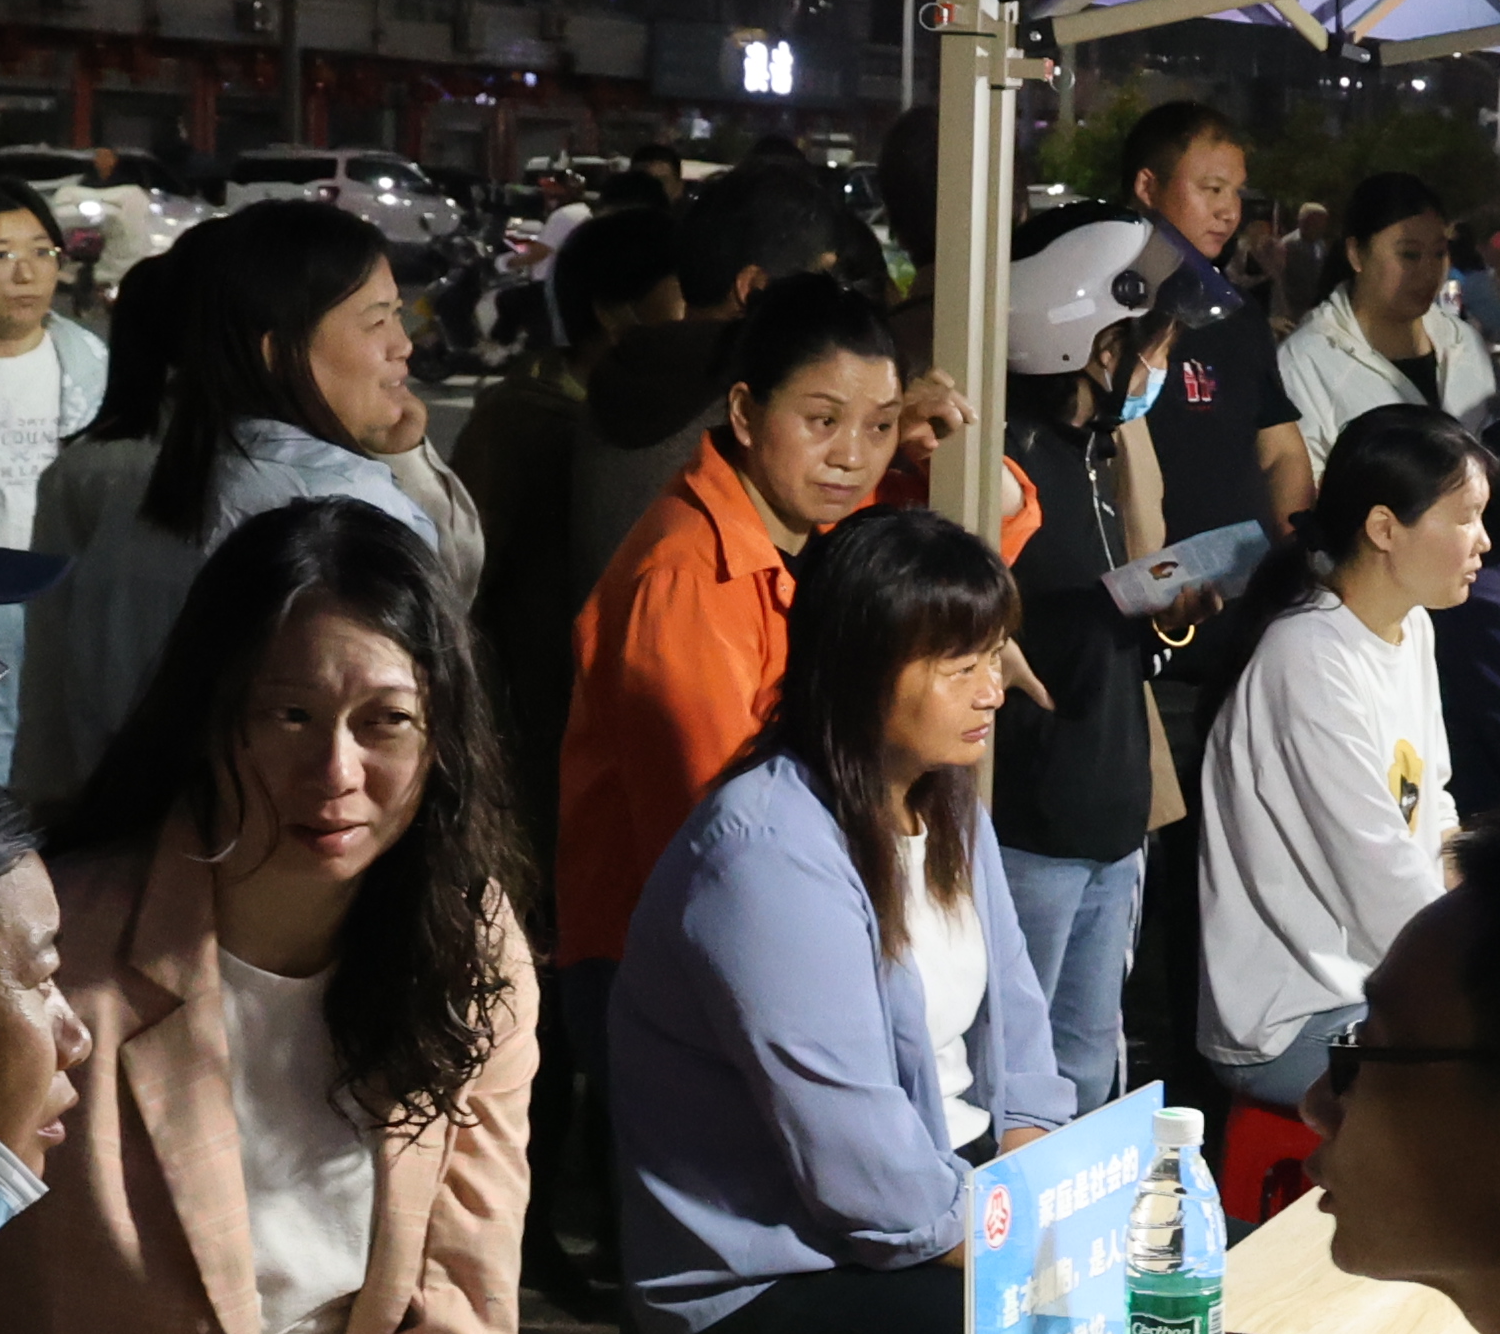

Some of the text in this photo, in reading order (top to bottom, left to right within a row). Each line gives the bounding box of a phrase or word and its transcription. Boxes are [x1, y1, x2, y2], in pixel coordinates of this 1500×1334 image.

[1038, 1143, 1140, 1229] 家庭是社会的
[1002, 1228, 1127, 1329] 基本细胞，是人
